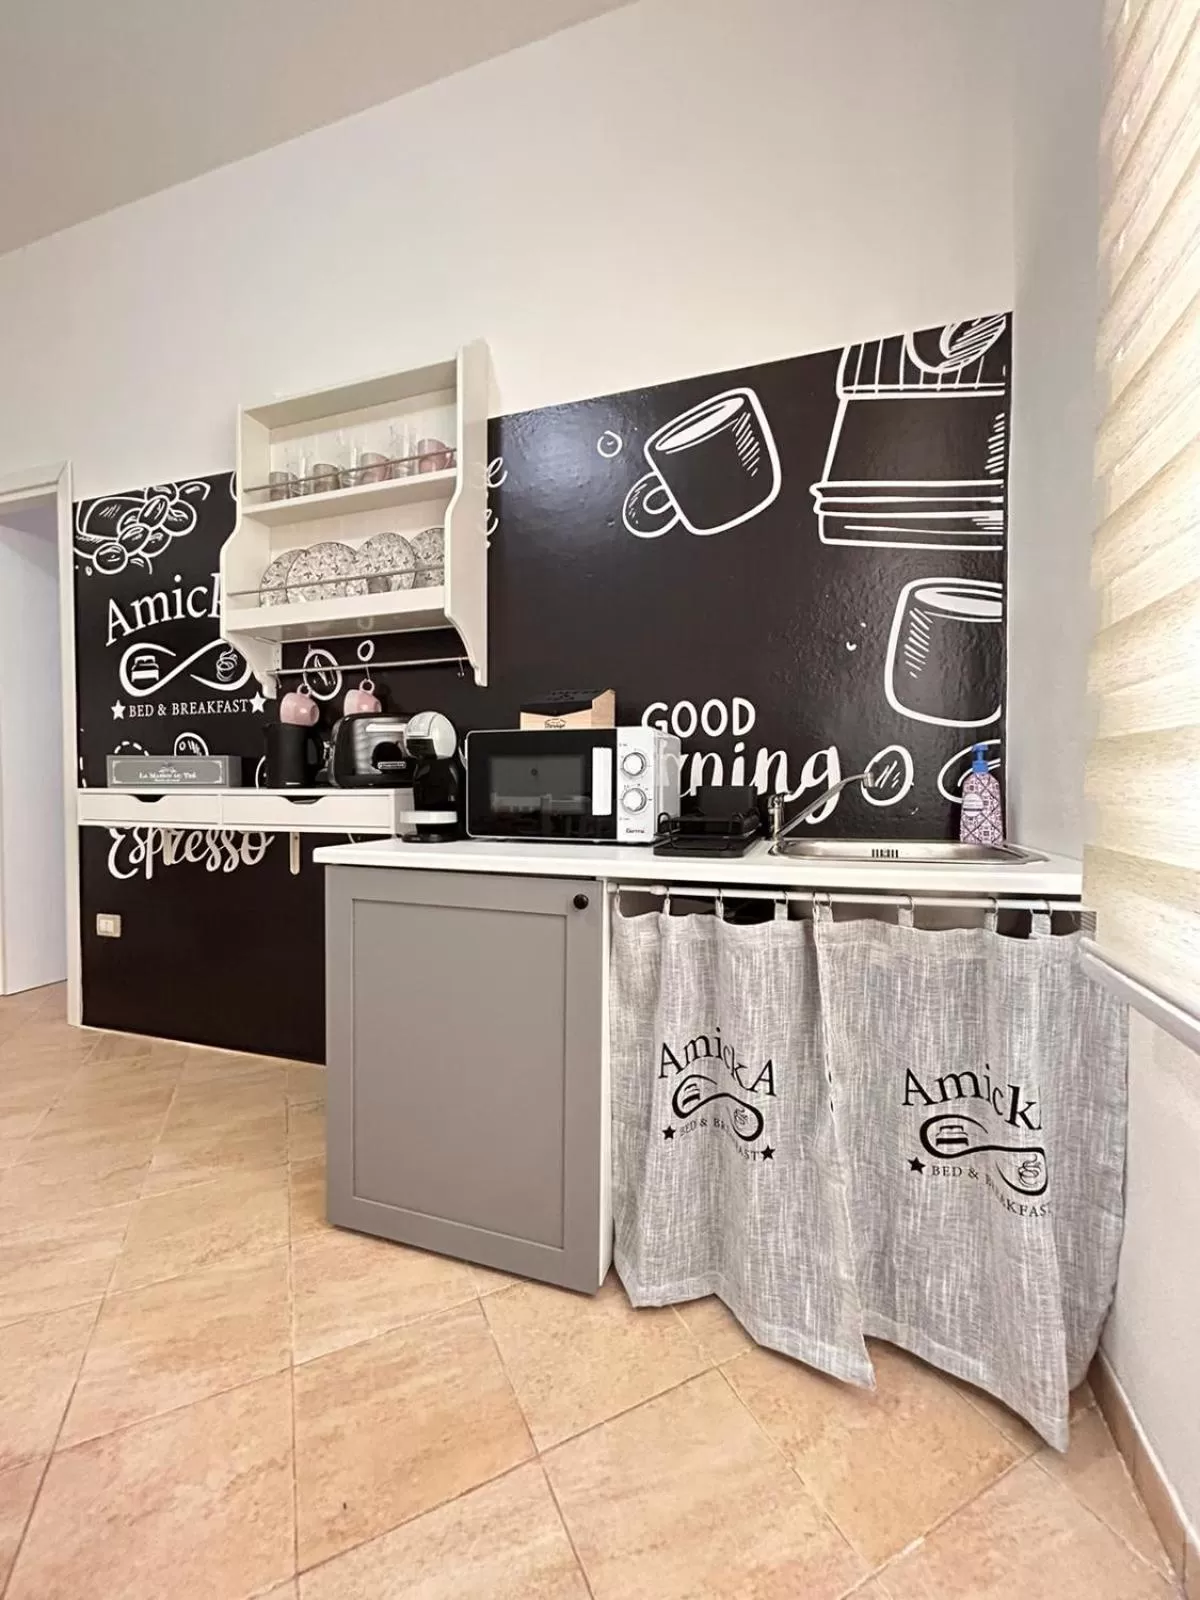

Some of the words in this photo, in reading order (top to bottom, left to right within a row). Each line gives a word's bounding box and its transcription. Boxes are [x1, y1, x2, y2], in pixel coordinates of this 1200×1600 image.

[129, 703, 154, 718] BED
[157, 703, 167, 716] &
[172, 698, 249, 716] BREAKFAST
[641, 697, 756, 738] GOOD
[107, 826, 276, 880] Espresso
[658, 1027, 777, 1097] AmickA
[931, 1164, 962, 1177] BED
[967, 1167, 979, 1180] &
